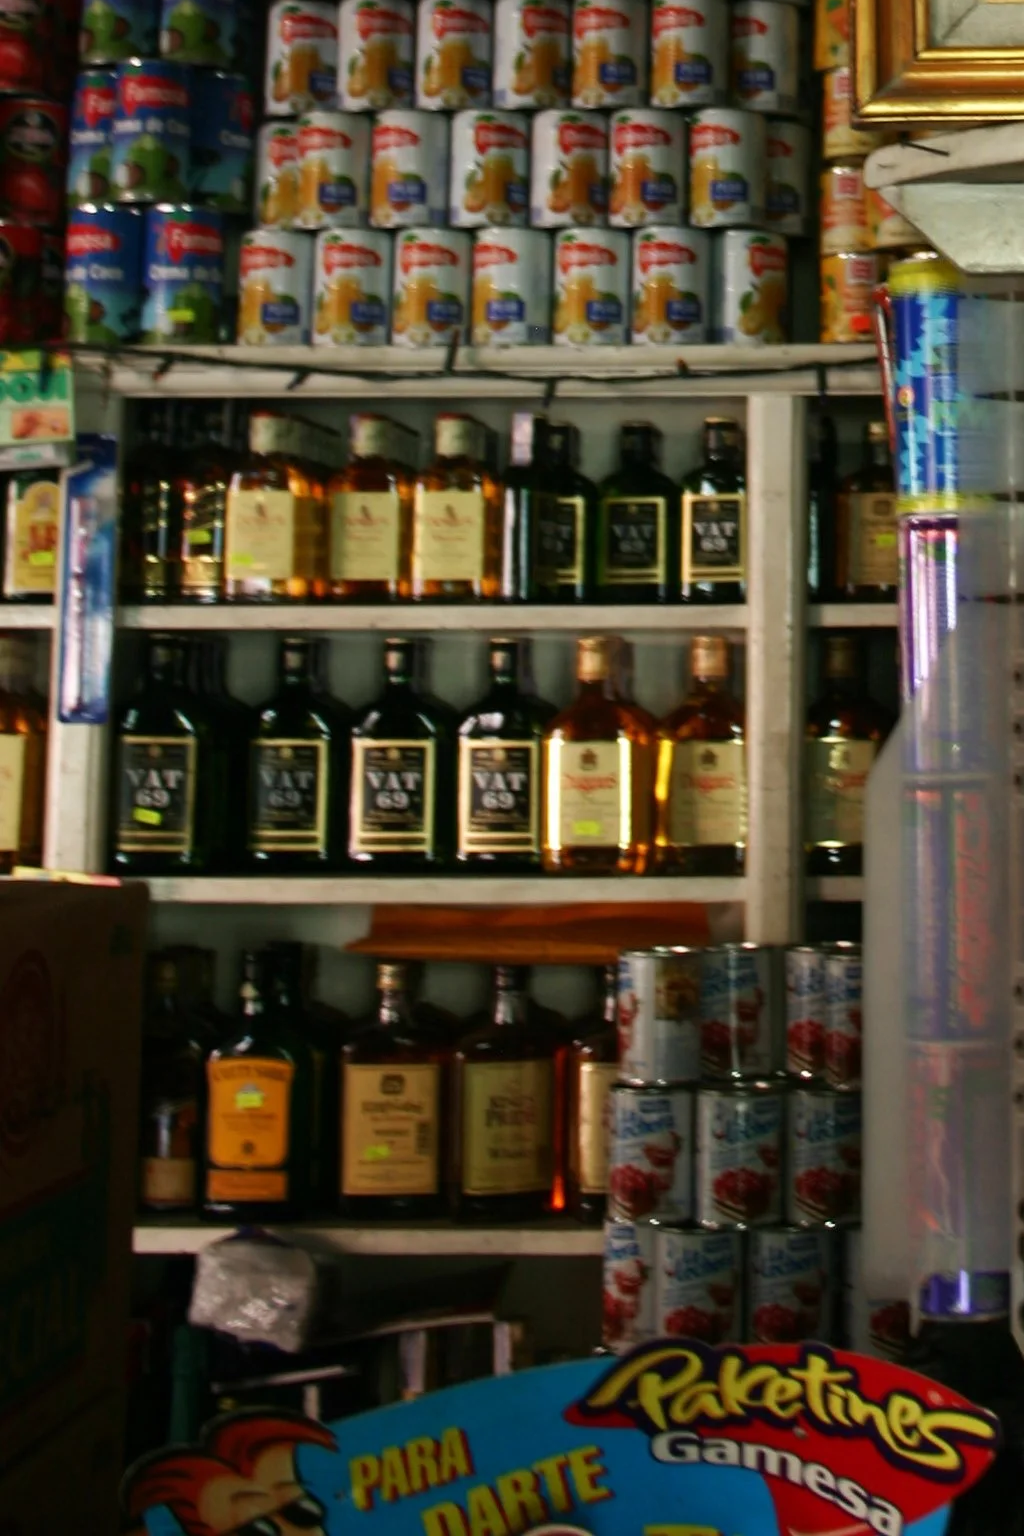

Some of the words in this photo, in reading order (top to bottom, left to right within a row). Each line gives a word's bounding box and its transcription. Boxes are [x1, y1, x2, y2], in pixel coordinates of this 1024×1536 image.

[693, 521, 738, 536] VAT
[126, 769, 184, 790] VAT
[258, 770, 314, 790] VAT
[365, 771, 422, 791] VAT
[471, 771, 528, 792] VAT
[134, 789, 171, 808] 69
[268, 789, 304, 809] 69
[375, 790, 411, 810] 69
[480, 791, 515, 810] 69
[587, 1347, 998, 1472] Paketines
[348, 1427, 474, 1511] PARA
[420, 1445, 614, 1536] DARTE
[650, 1430, 902, 1536] Gamesa
